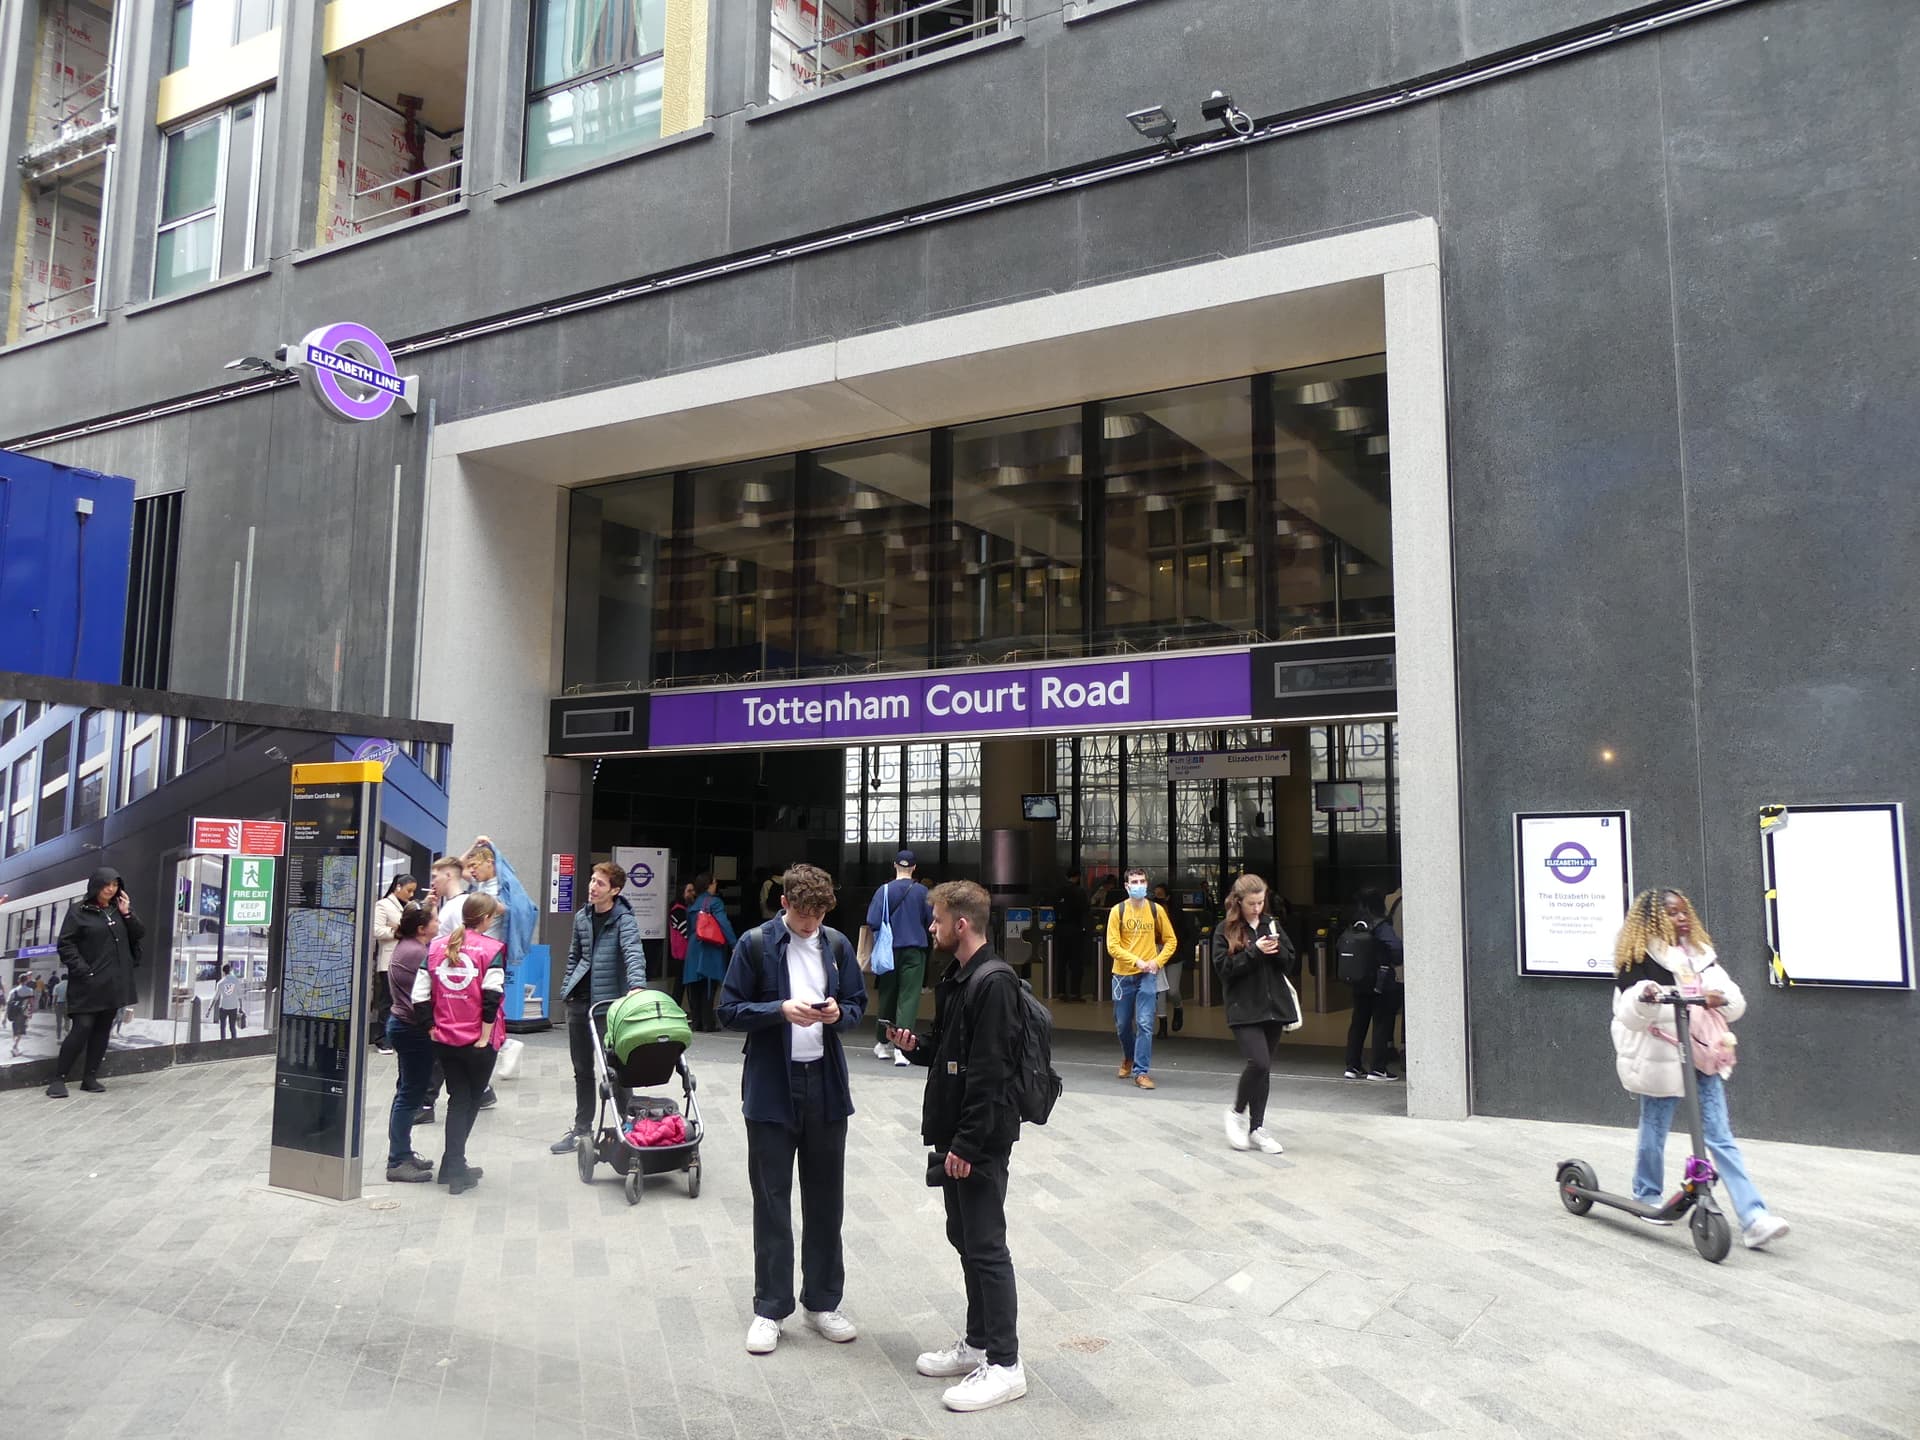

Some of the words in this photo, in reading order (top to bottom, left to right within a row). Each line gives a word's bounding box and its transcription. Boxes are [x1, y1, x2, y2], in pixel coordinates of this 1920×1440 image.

[311, 349, 373, 382] ELIZABETH
[375, 373, 401, 393] LINE
[743, 691, 910, 727] Tottenham
[926, 682, 1026, 716] Court
[1041, 671, 1131, 710] Road
[1227, 754, 1263, 763] Elizabeth
[1555, 892, 1589, 900] Elizabeth
[1576, 901, 1595, 909] open
[237, 911, 261, 919] CLEAR
